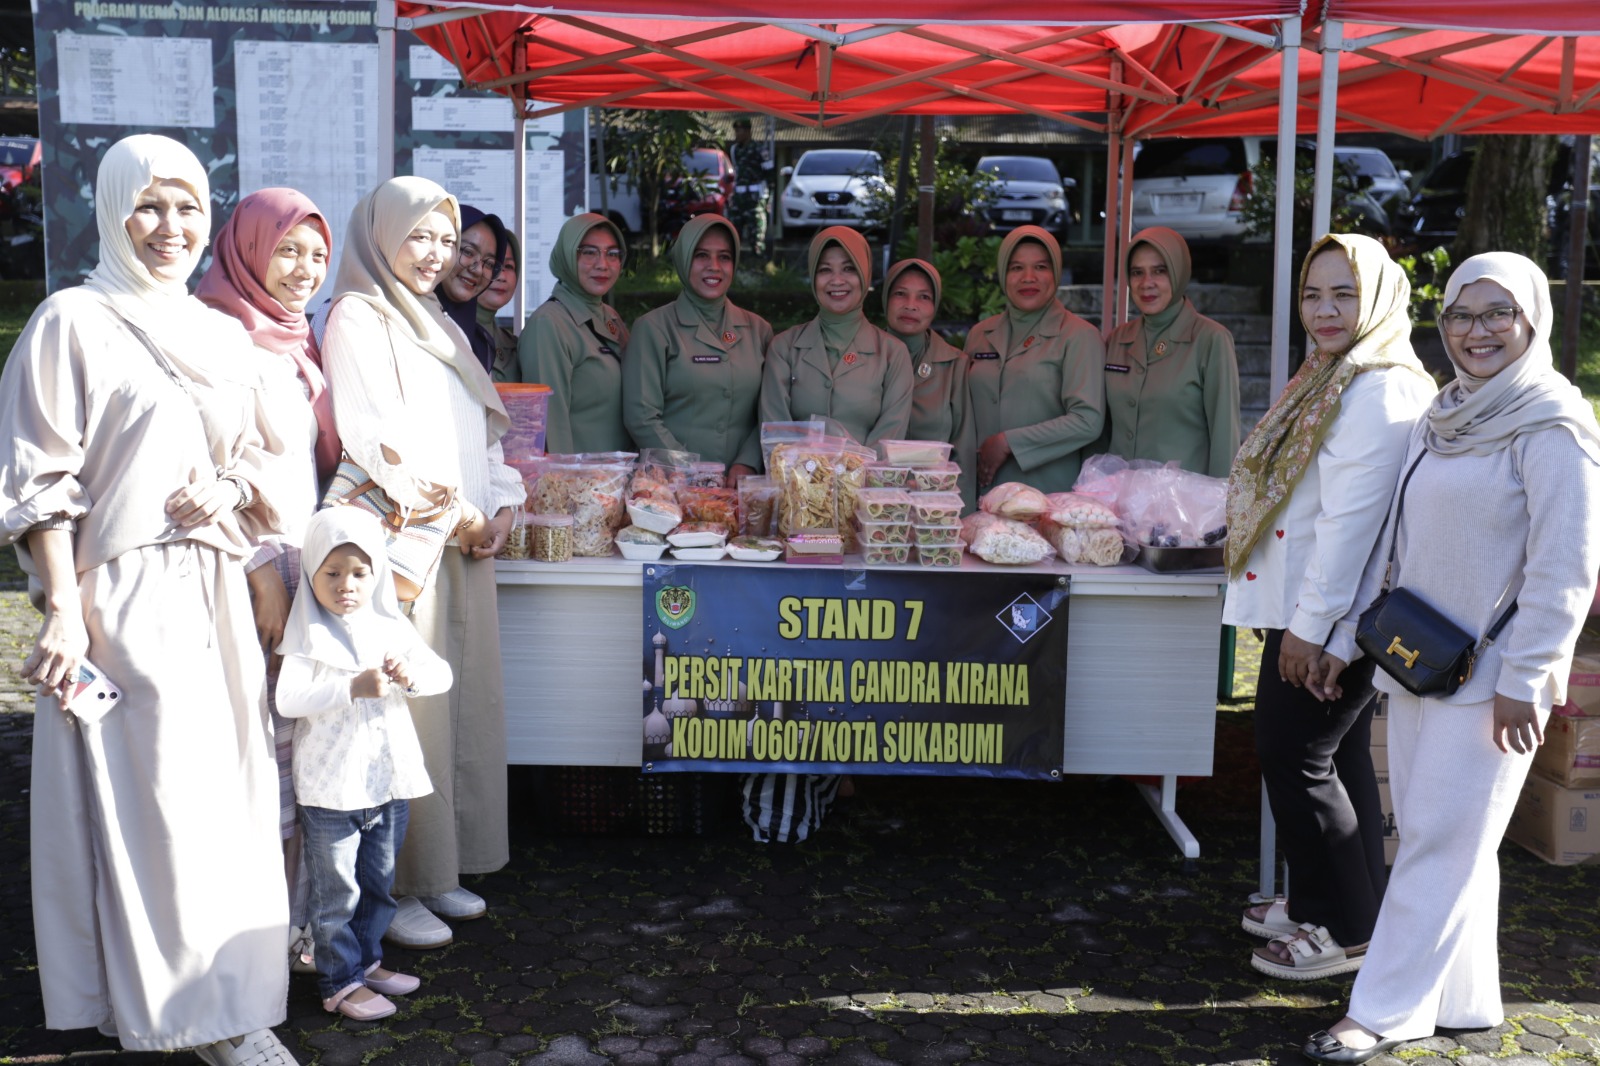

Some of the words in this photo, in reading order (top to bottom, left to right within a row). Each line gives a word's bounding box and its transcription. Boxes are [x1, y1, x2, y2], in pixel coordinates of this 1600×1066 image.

[74, 2, 137, 19] PROGRAM
[139, 4, 177, 20] KERJA
[178, 6, 204, 21] DAN
[206, 6, 259, 23] ALOKASI
[260, 8, 328, 25] ANGGARAN
[329, 10, 371, 26] KODIM
[779, 596, 896, 641] STAND
[904, 600, 924, 641] 7
[664, 656, 743, 701] PERSIT
[746, 658, 845, 703] KARTIKA
[850, 660, 941, 704] CANDRA
[945, 662, 1030, 706] KIRANA
[672, 717, 747, 760] KODIM
[752, 719, 879, 762] 0607/KOTA
[883, 721, 1004, 764] SUKABUMI
